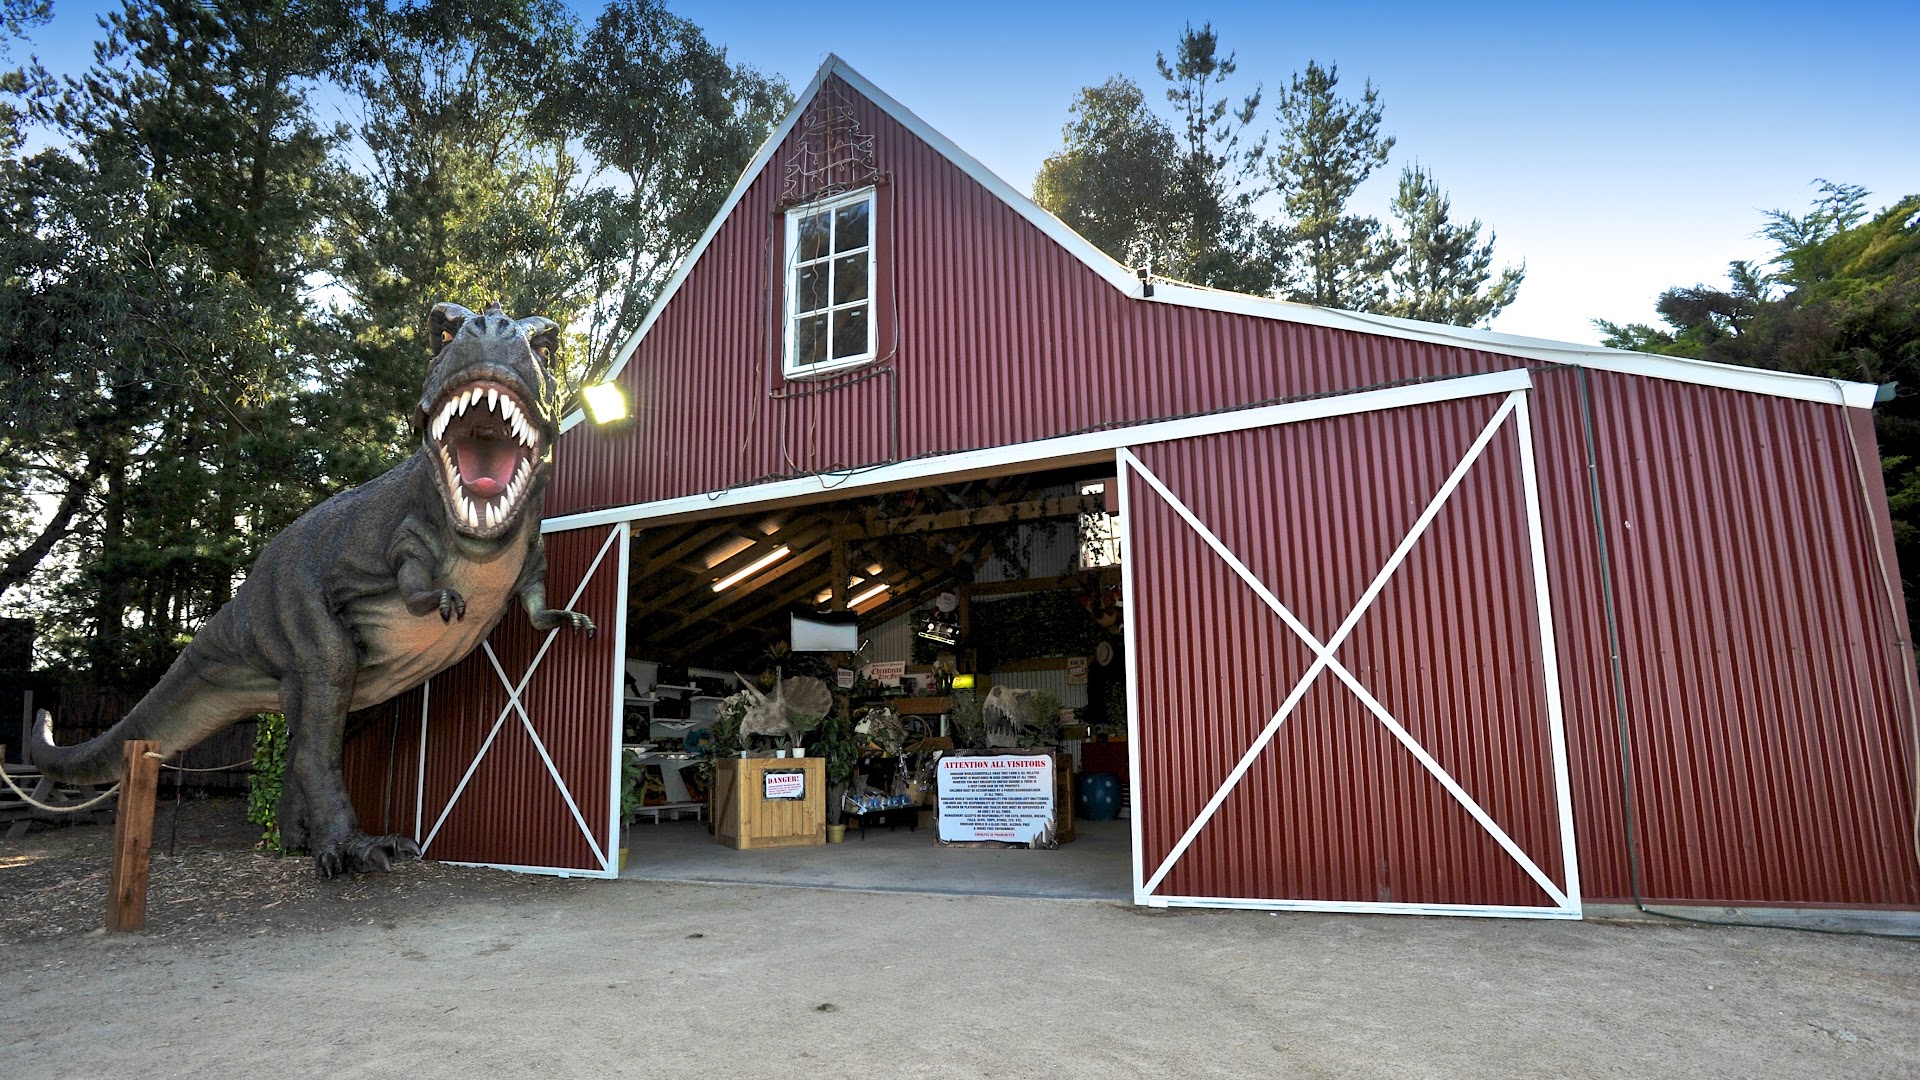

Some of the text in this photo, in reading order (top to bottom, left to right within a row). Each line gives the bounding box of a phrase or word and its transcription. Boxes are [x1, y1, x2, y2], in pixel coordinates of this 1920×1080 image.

[944, 760, 1046, 769] ATTENTION ALL VISITORS
[768, 775, 800, 784] DANGER!
